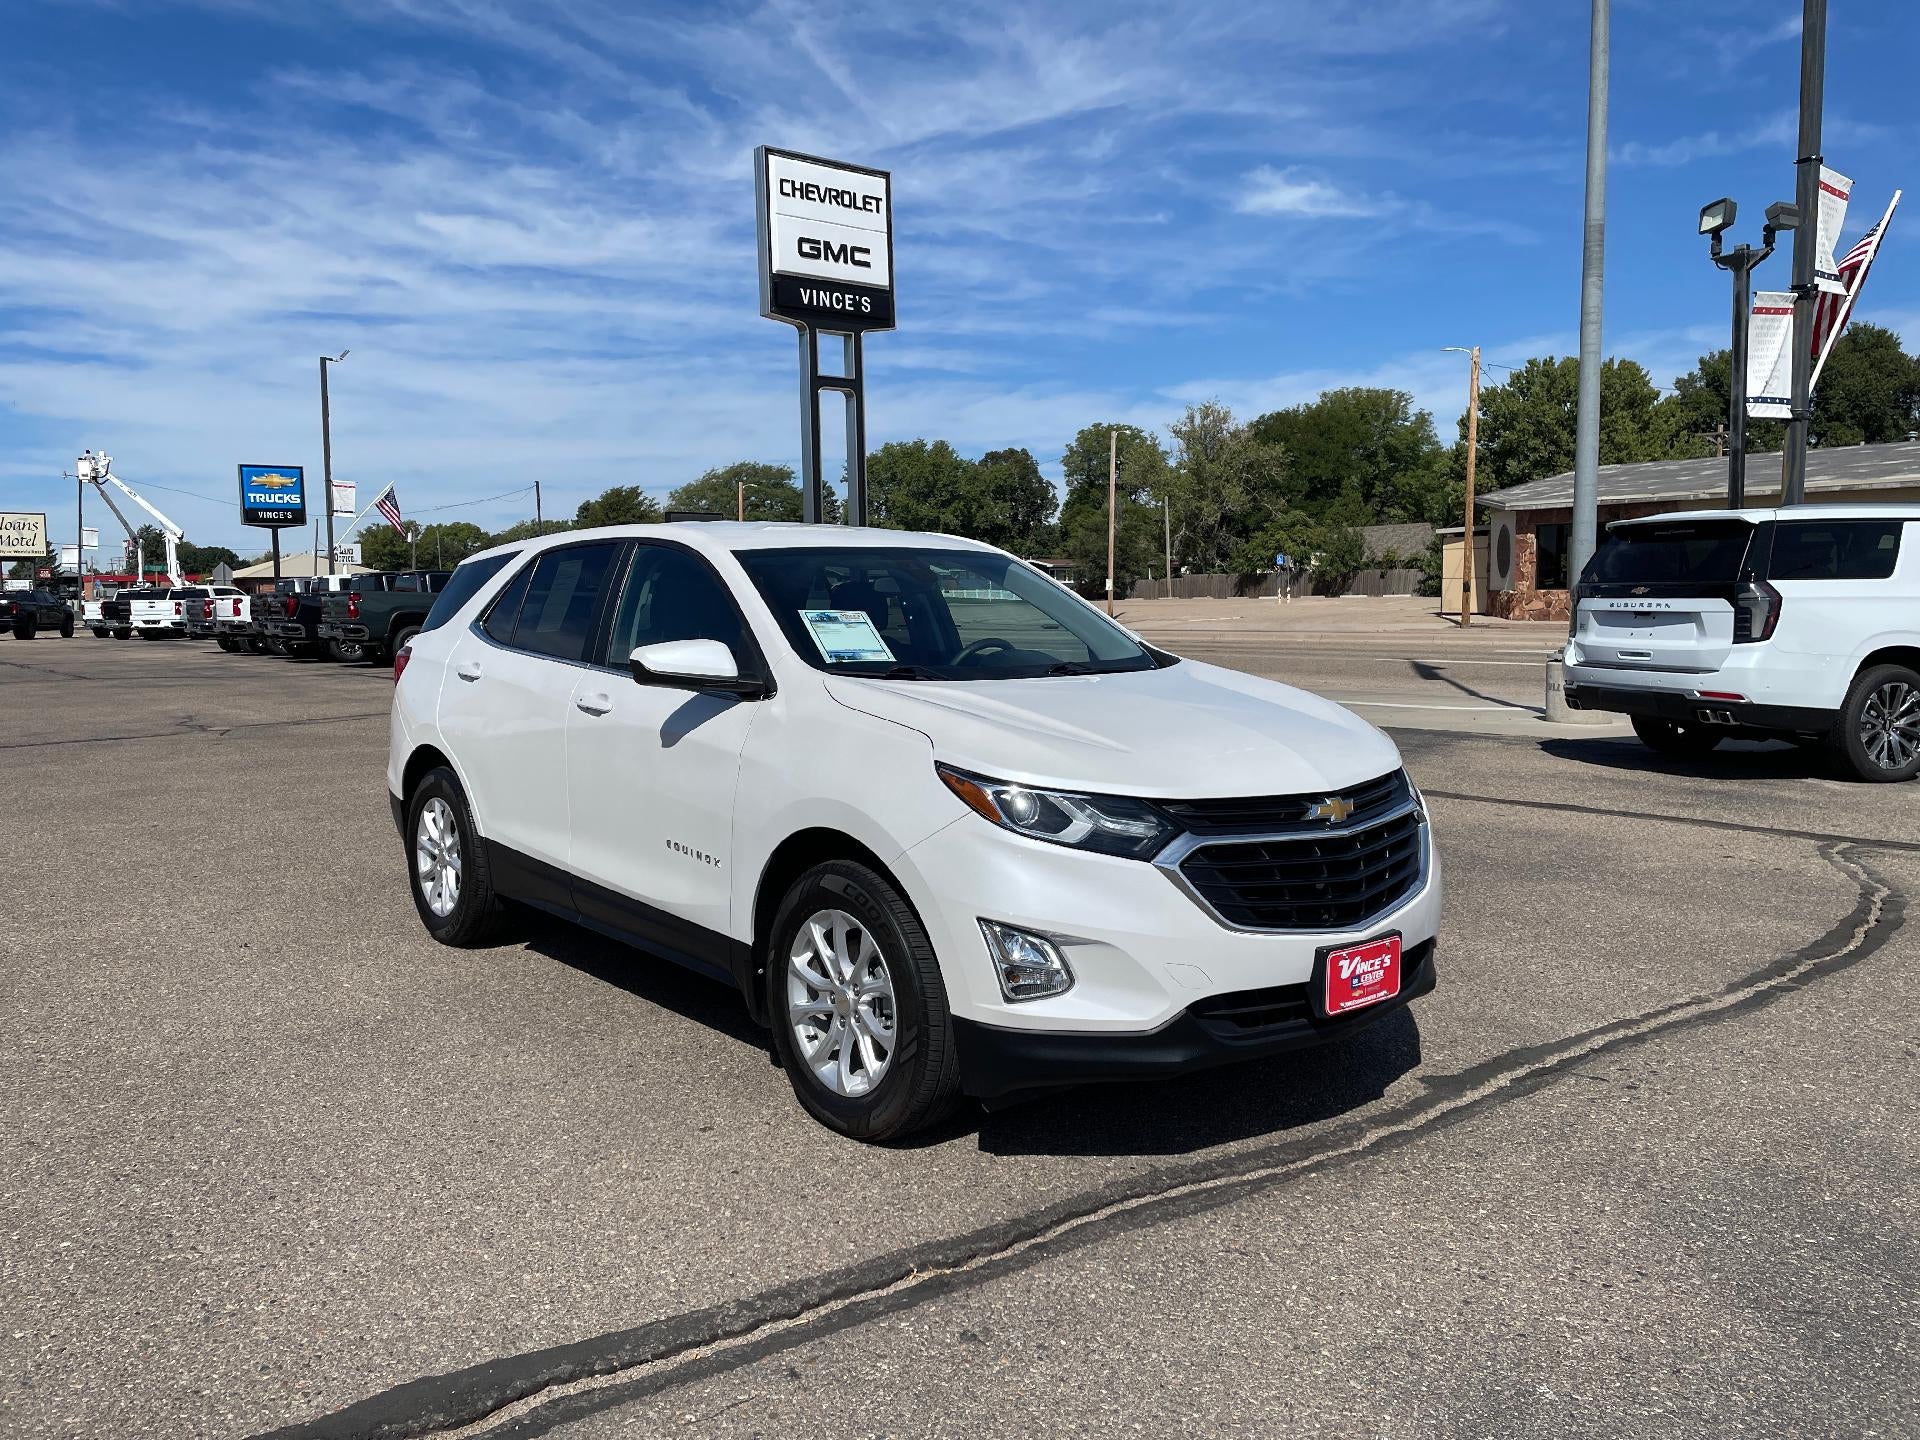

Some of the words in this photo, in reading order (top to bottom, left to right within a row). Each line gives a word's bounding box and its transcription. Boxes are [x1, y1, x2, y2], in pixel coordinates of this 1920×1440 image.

[779, 178, 883, 215] CHEVROLET
[797, 236, 872, 269] GMC
[799, 287, 872, 313] VINCE'S
[247, 493, 301, 504] TRUCKS
[257, 511, 293, 520] VINCE'S
[1608, 601, 1672, 610] SUBURBAN
[665, 839, 722, 869] EQUINOX
